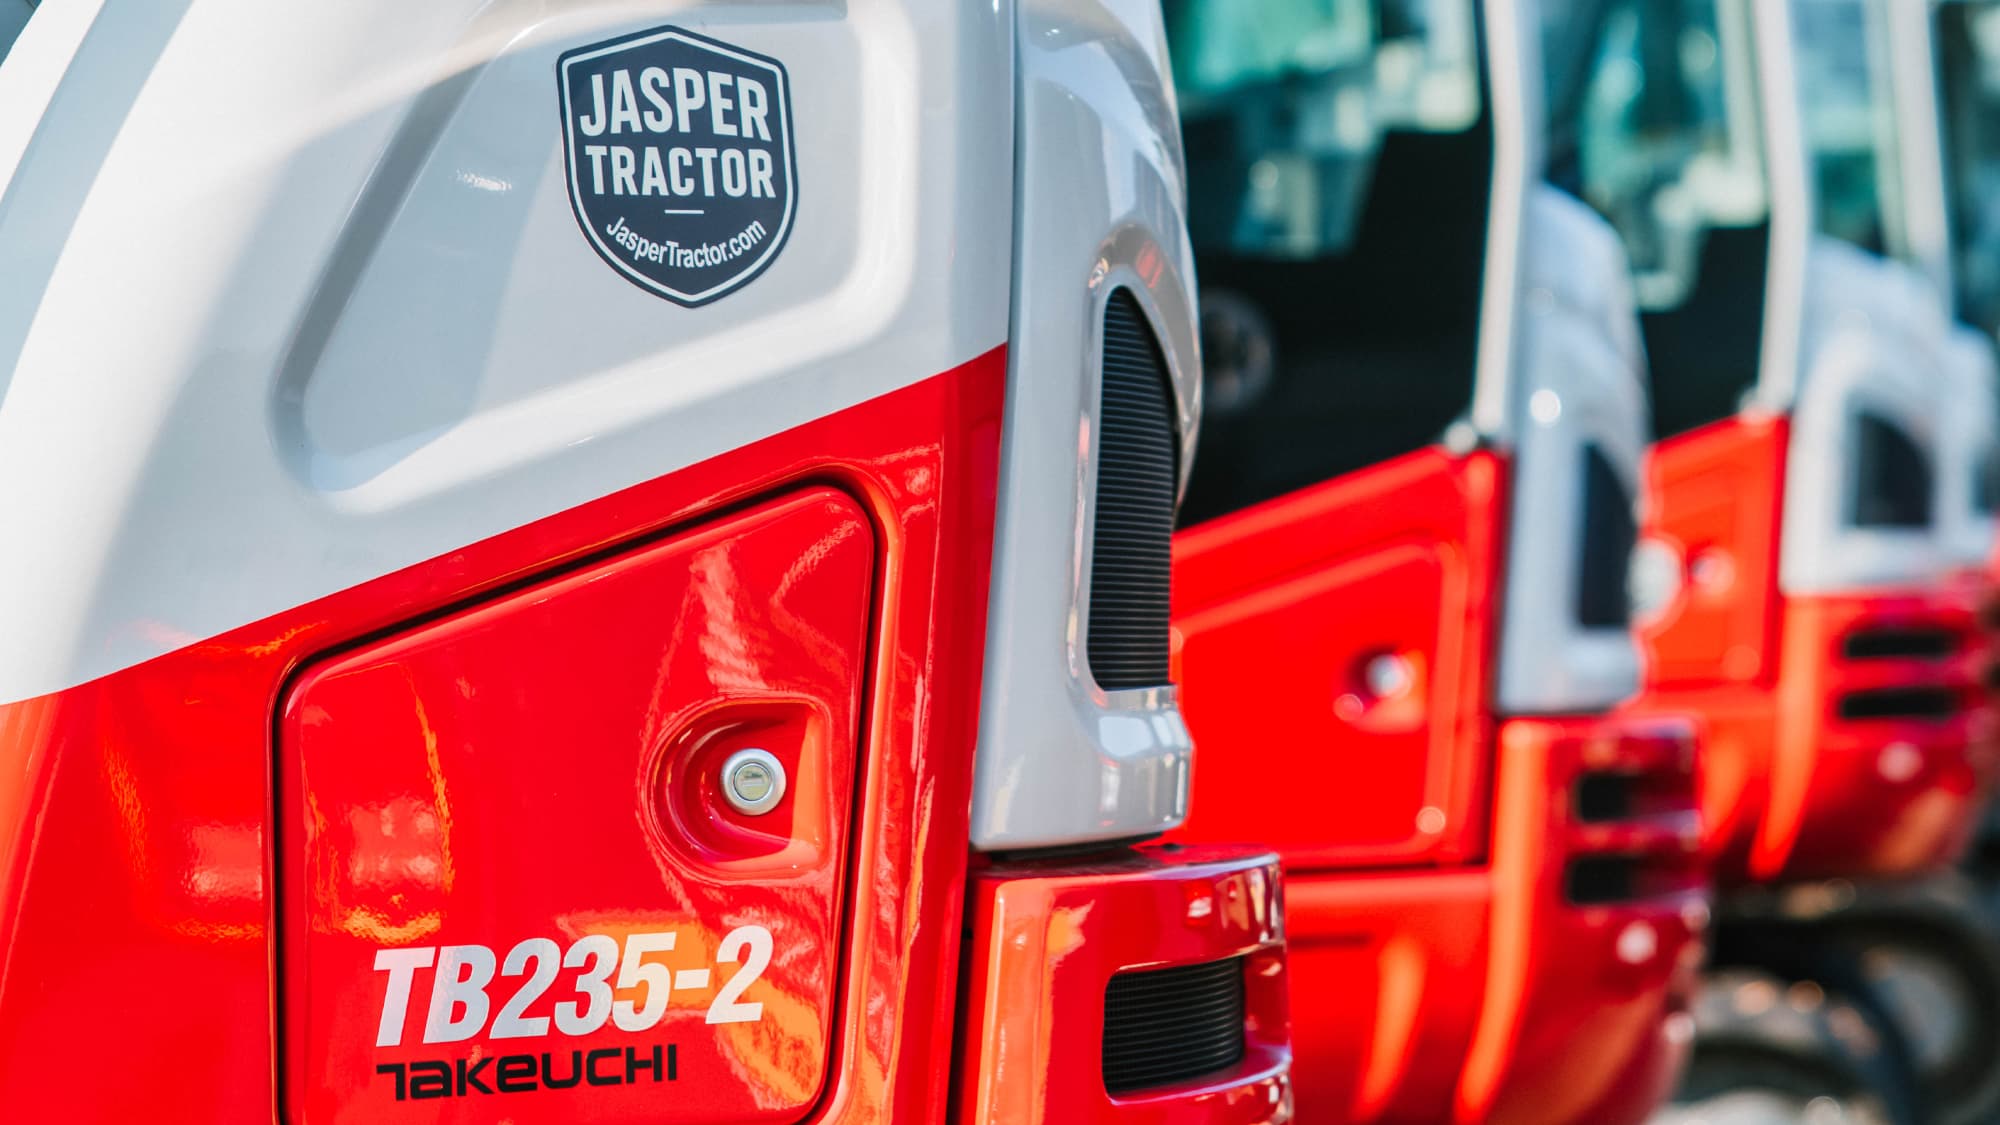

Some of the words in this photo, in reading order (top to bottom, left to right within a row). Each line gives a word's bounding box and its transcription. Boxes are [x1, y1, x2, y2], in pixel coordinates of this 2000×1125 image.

[580, 67, 772, 142] JASPER
[585, 145, 776, 198] TRACTOR
[606, 216, 767, 268] JasperTractor.com
[373, 925, 773, 1047] TB235-2
